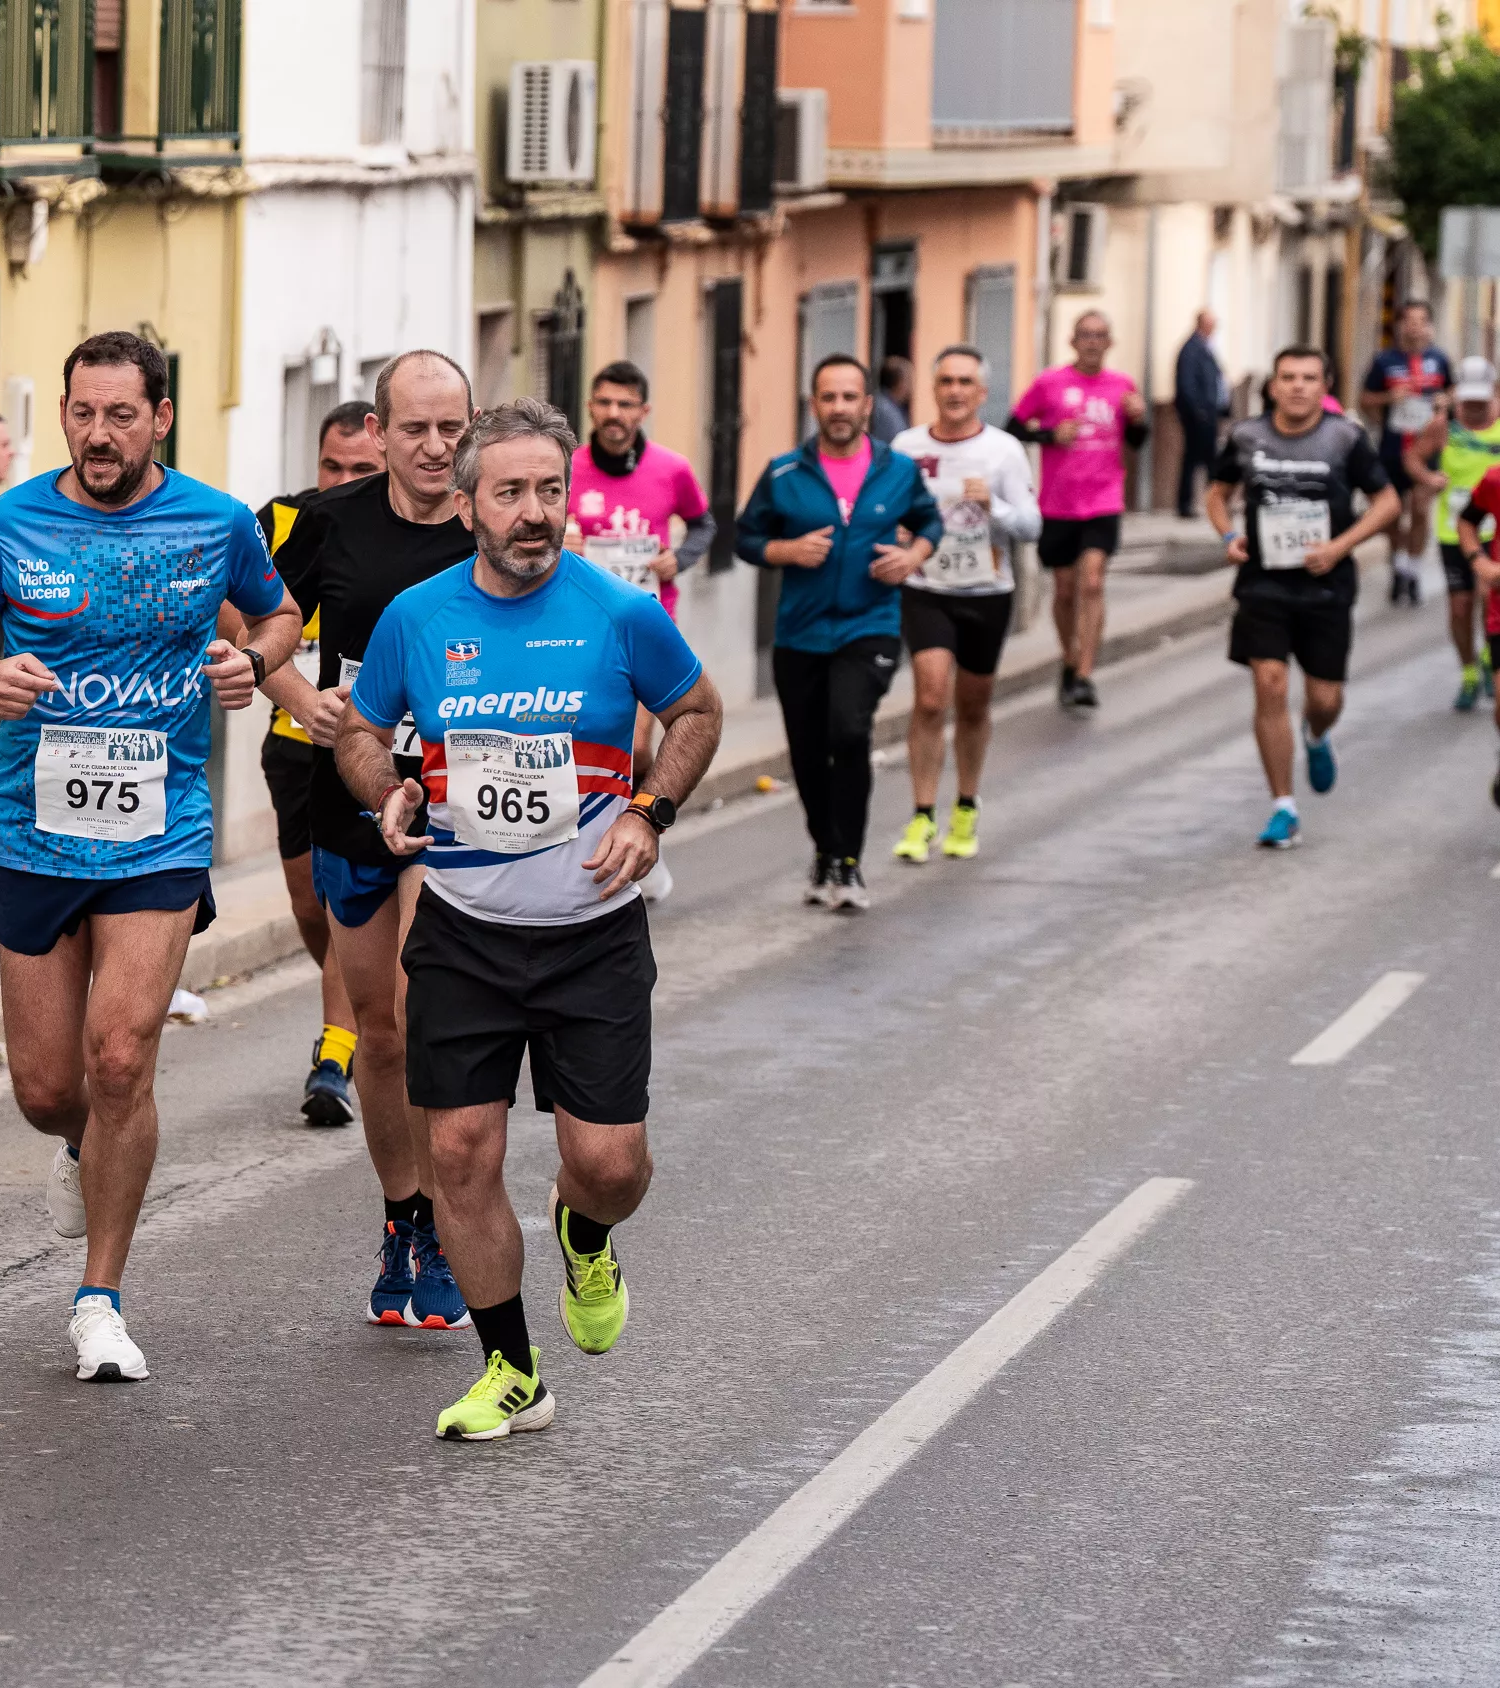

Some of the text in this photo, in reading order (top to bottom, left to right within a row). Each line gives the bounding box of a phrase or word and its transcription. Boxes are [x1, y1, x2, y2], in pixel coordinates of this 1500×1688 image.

[17, 559, 49, 572] Club
[19, 570, 75, 586] Maratón
[170, 578, 211, 589] enerplus
[20, 587, 70, 599] Lucena
[526, 640, 574, 648] GSPORT
[438, 687, 584, 718] enerplus
[516, 712, 577, 723] directo
[72, 737, 106, 745] POPULARES
[107, 732, 141, 745] 2024
[513, 740, 545, 754] 2024
[66, 779, 140, 813] 975
[477, 785, 550, 824] 965
